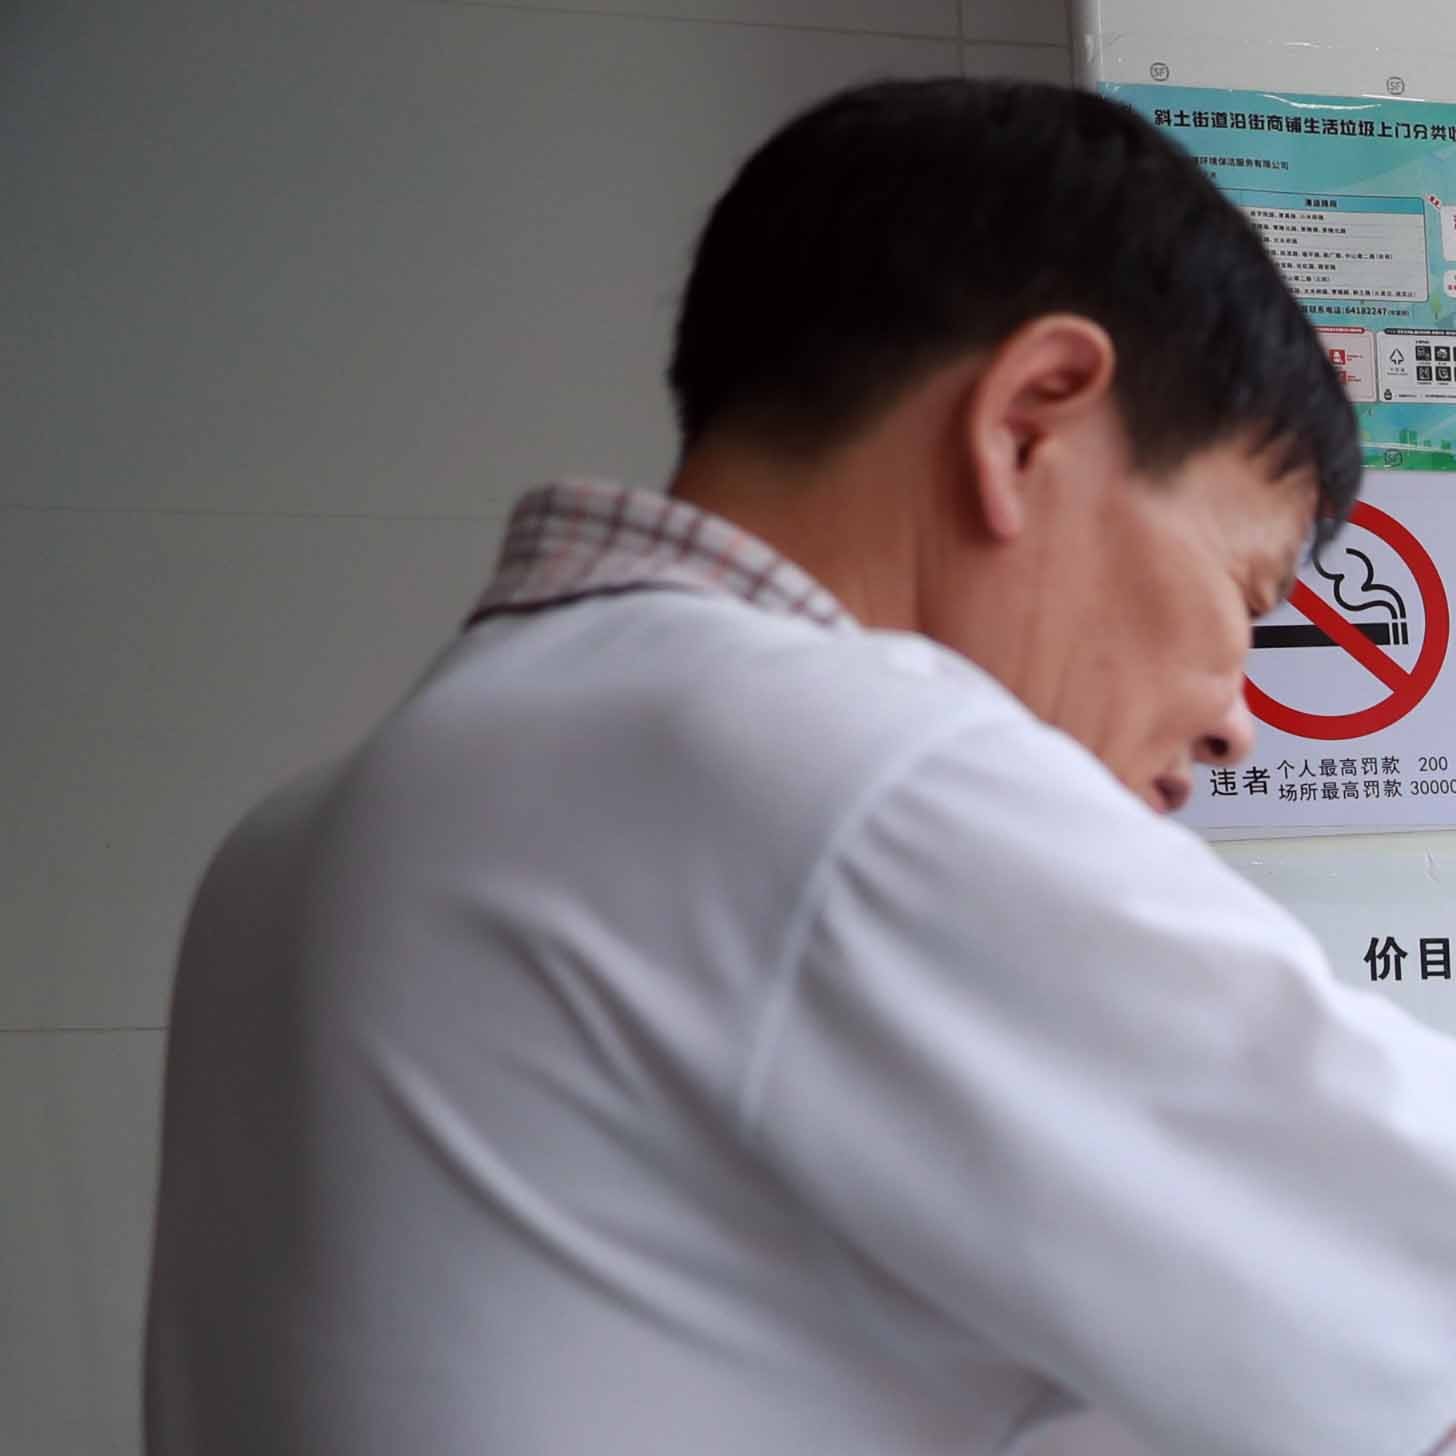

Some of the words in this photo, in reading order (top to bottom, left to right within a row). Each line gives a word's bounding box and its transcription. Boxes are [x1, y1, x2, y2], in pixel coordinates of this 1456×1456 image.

[1276, 755, 1401, 779] 个人最高罚款
[1418, 756, 1448, 772] 200
[1209, 764, 1271, 797] 违者
[1278, 779, 1402, 802] 场所最高罚款
